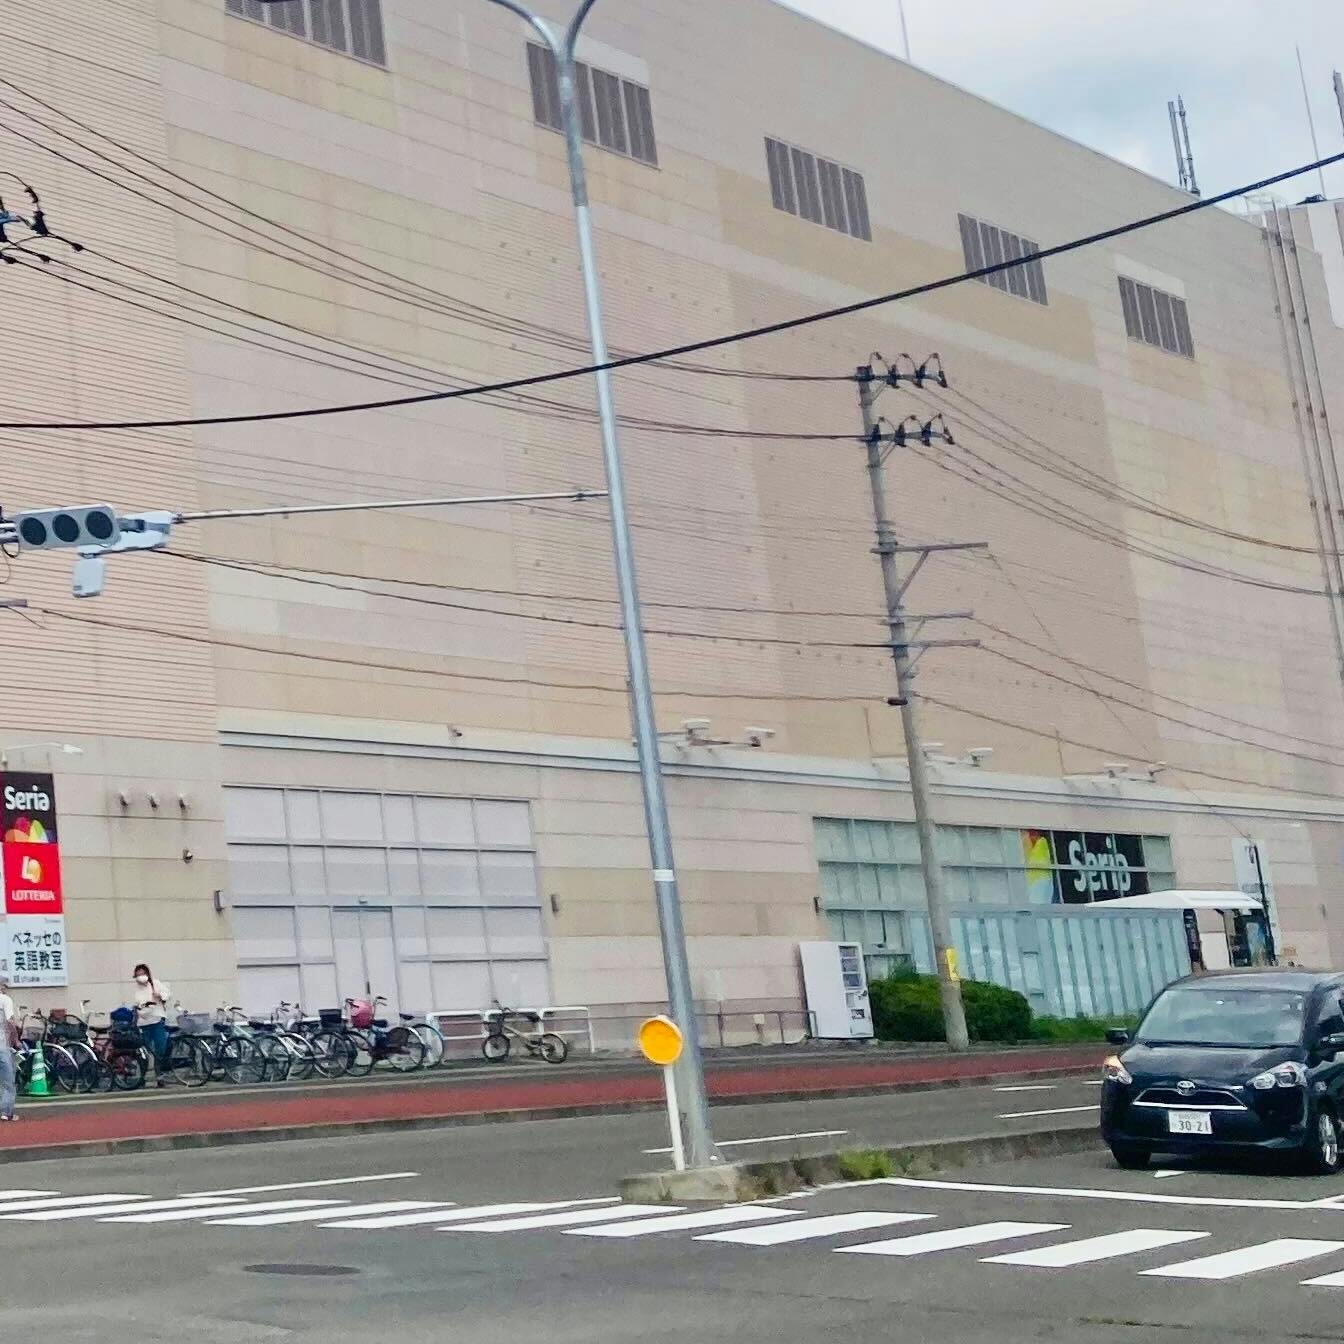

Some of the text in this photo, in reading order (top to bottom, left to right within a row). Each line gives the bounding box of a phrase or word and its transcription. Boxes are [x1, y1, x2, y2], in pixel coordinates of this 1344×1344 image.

[4, 785, 50, 811] Seria
[12, 889, 55, 901] LOTTERIA
[12, 929, 62, 947] ベネッセの
[14, 950, 63, 971] 英語教室
